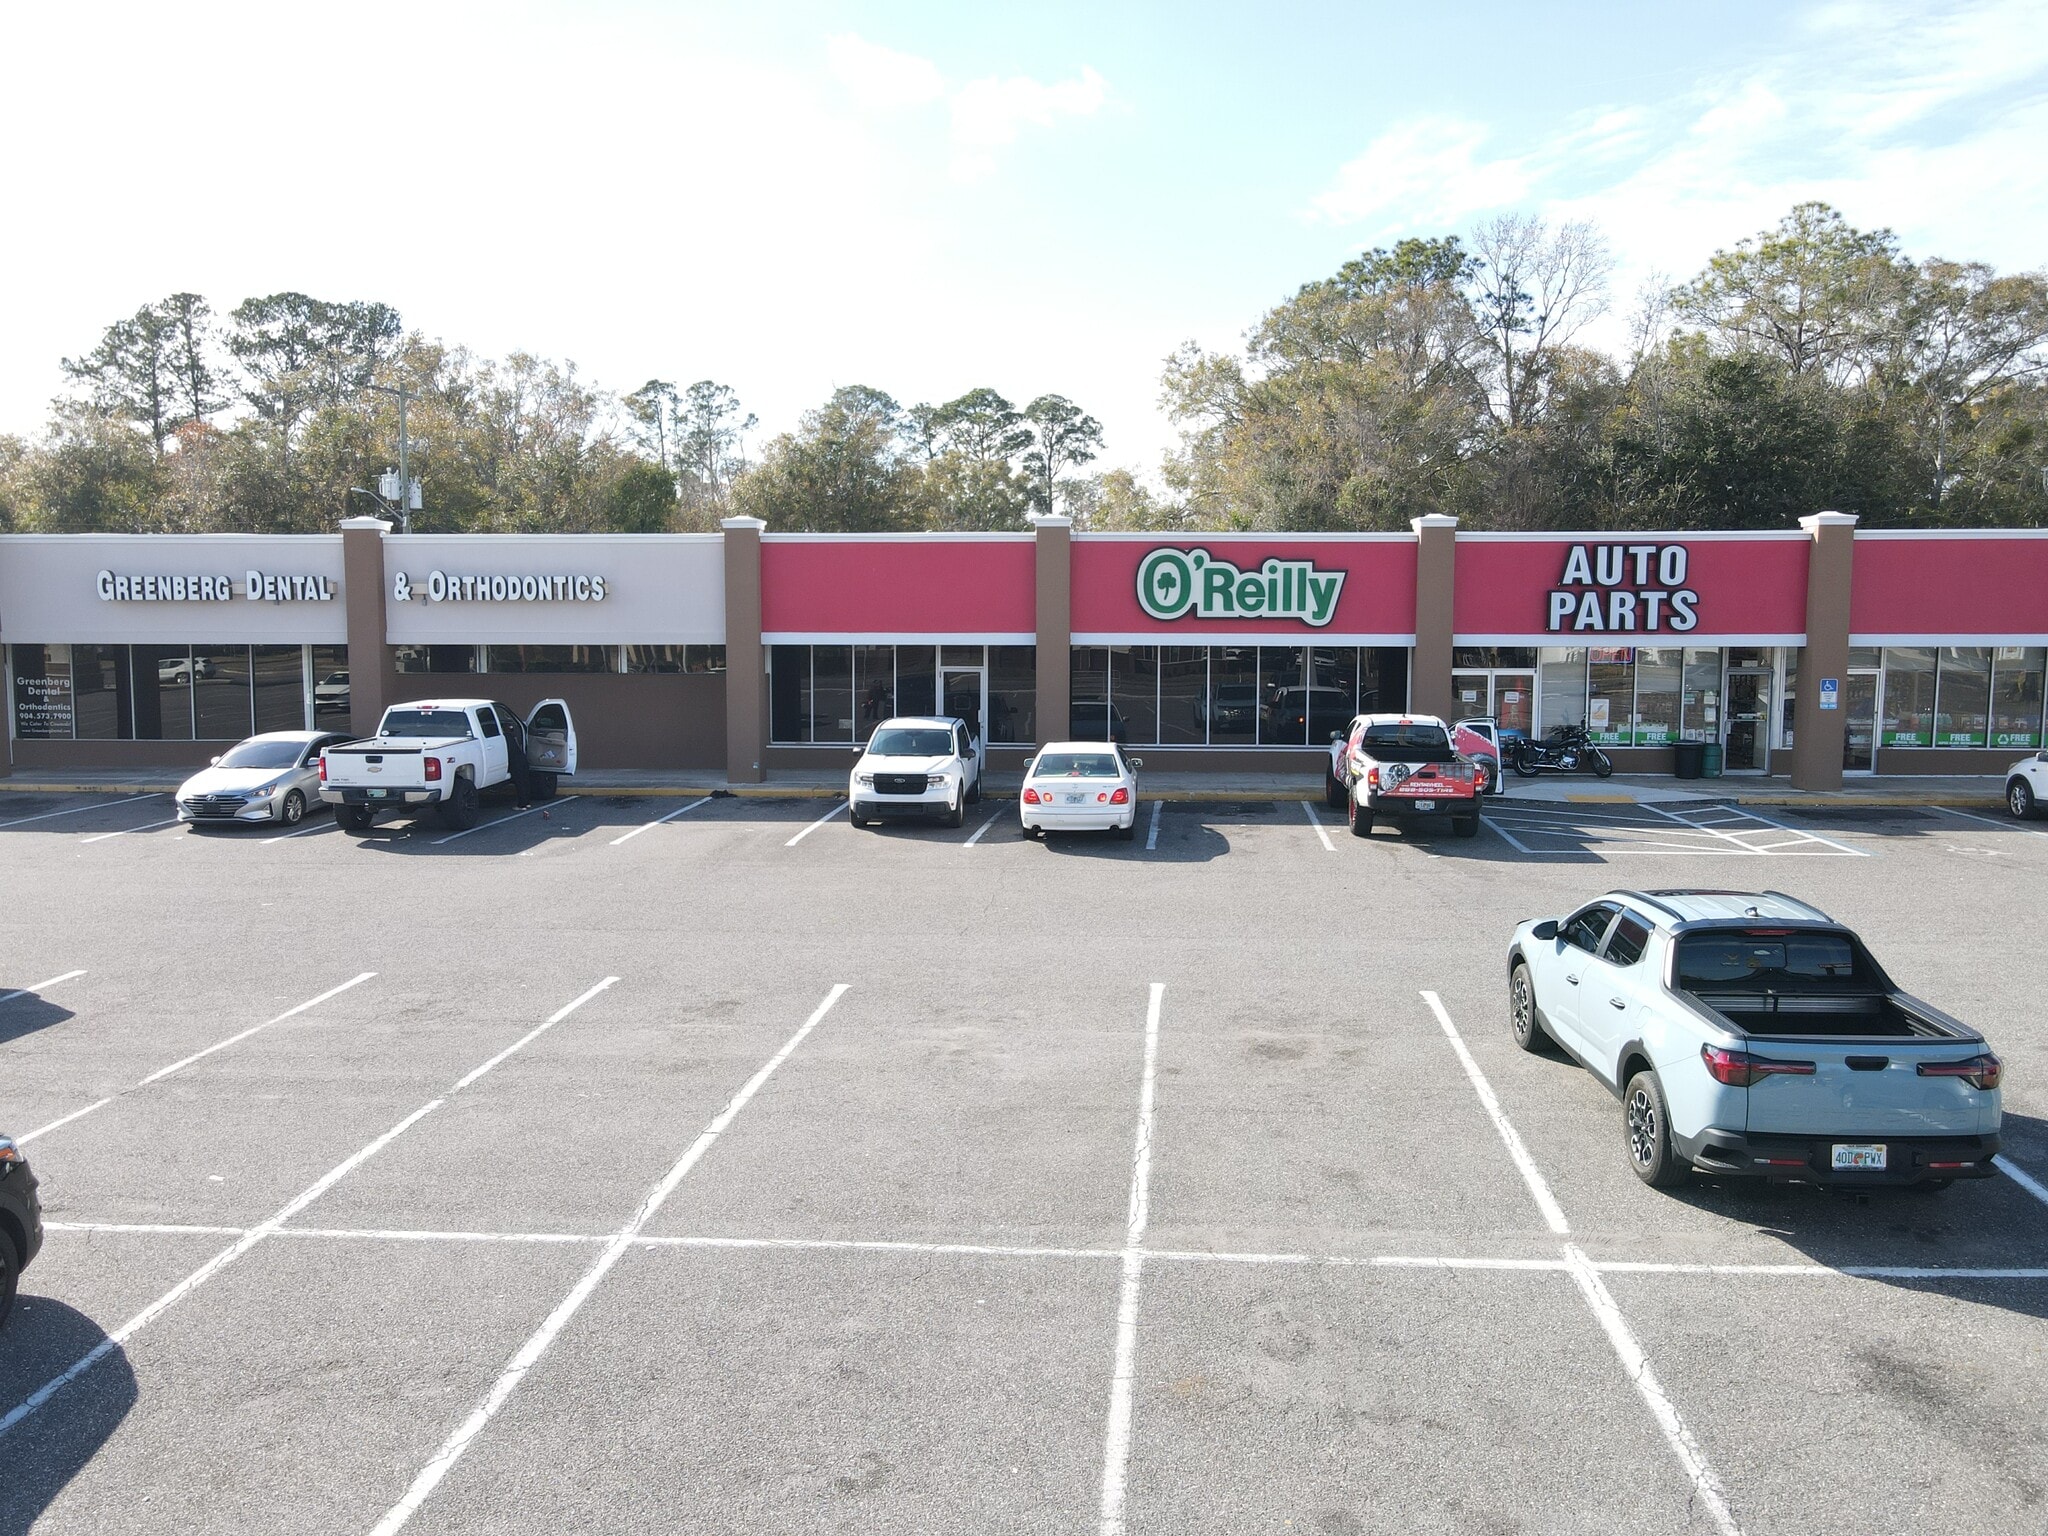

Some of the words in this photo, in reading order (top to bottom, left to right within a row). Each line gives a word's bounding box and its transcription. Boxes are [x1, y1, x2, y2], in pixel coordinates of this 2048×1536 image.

[1562, 545, 1687, 586] AUTO
[96, 570, 232, 601] GREENBERG
[245, 570, 332, 601] DENTAL
[393, 571, 413, 602] &
[427, 570, 605, 602] ORTHODONTICS
[1142, 553, 1339, 620] O'Reilly
[1549, 590, 1699, 631] PARTS
[1590, 647, 1632, 662] OPEN
[16, 676, 71, 688] Greenberg
[27, 687, 60, 695] Dental
[18, 702, 71, 711] Orthodontics
[1599, 732, 1620, 741] FREE
[1646, 732, 1667, 741] FREE
[1895, 732, 1917, 741] FREE
[1950, 733, 1971, 742] FREE
[2010, 733, 2031, 742] FREE
